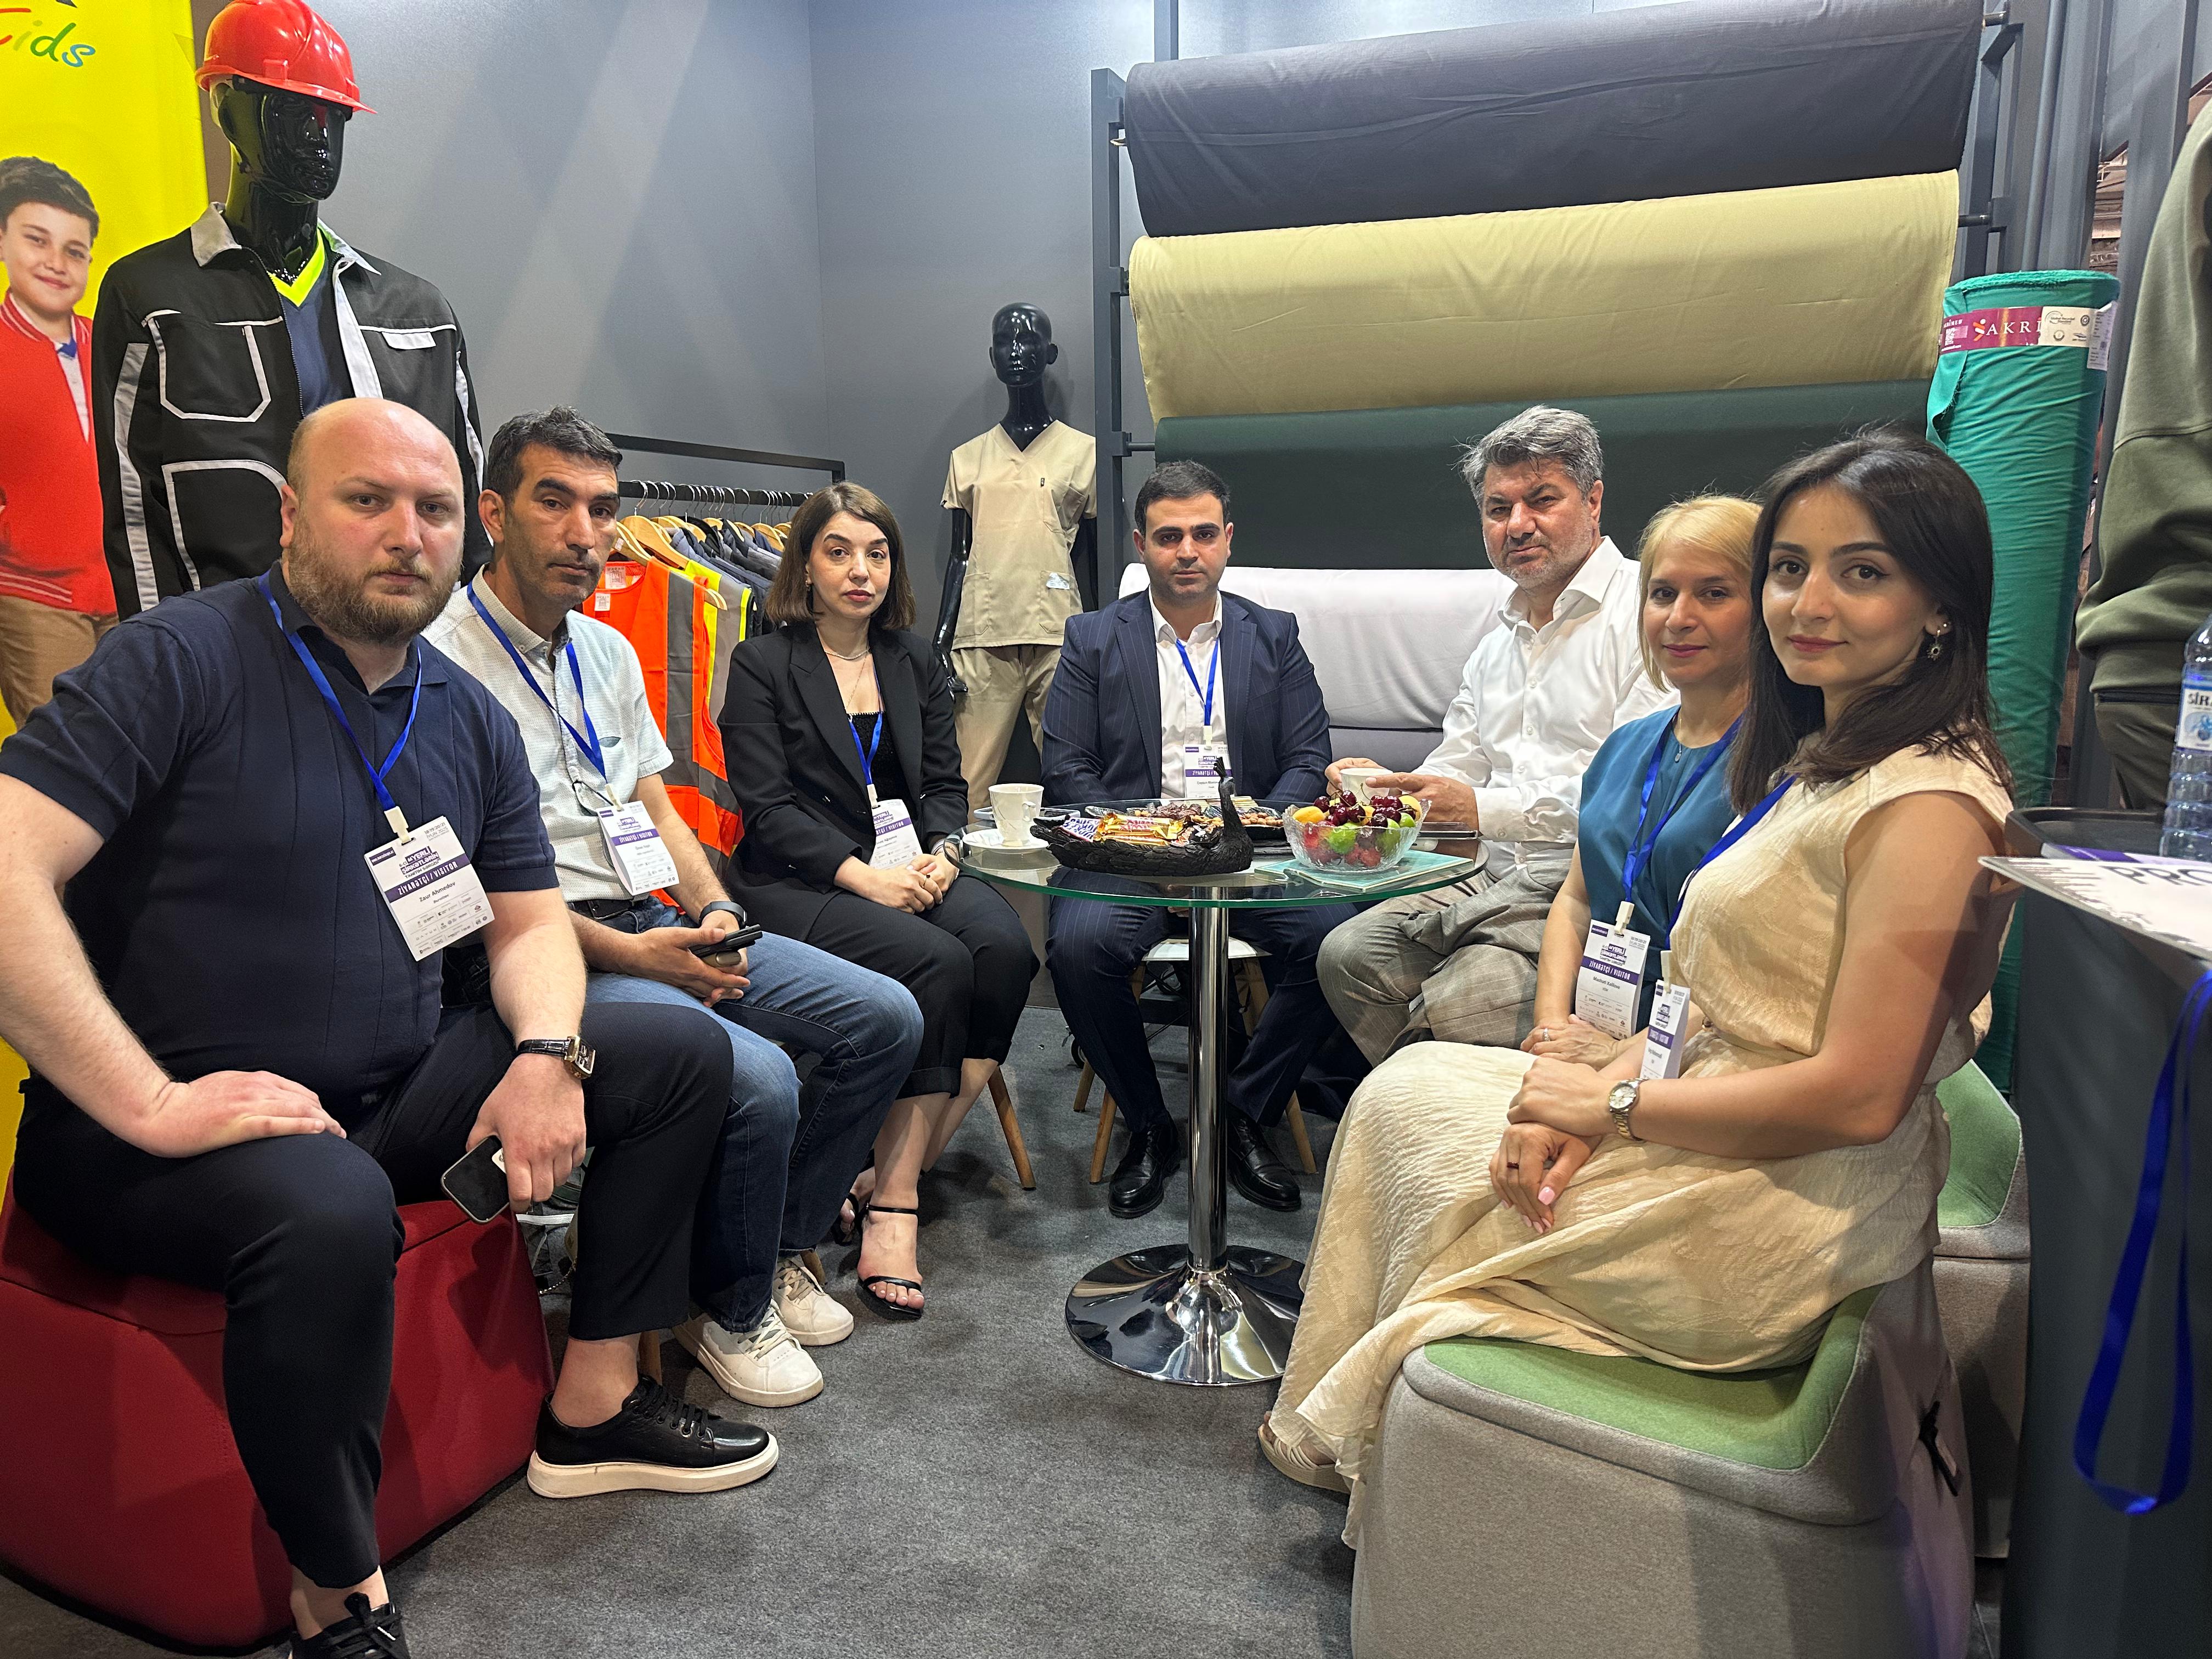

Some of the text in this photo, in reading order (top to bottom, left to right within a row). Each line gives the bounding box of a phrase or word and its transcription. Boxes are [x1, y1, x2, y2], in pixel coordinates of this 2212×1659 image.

[2187, 692, 2212, 706] SİR
[398, 873, 430, 895] ZİYARƏTÇİ
[433, 861, 458, 878] VISITOR
[419, 893, 431, 902] Zaur
[432, 882, 455, 895] Ahmedov
[1613, 969, 1630, 980] VISITOR
